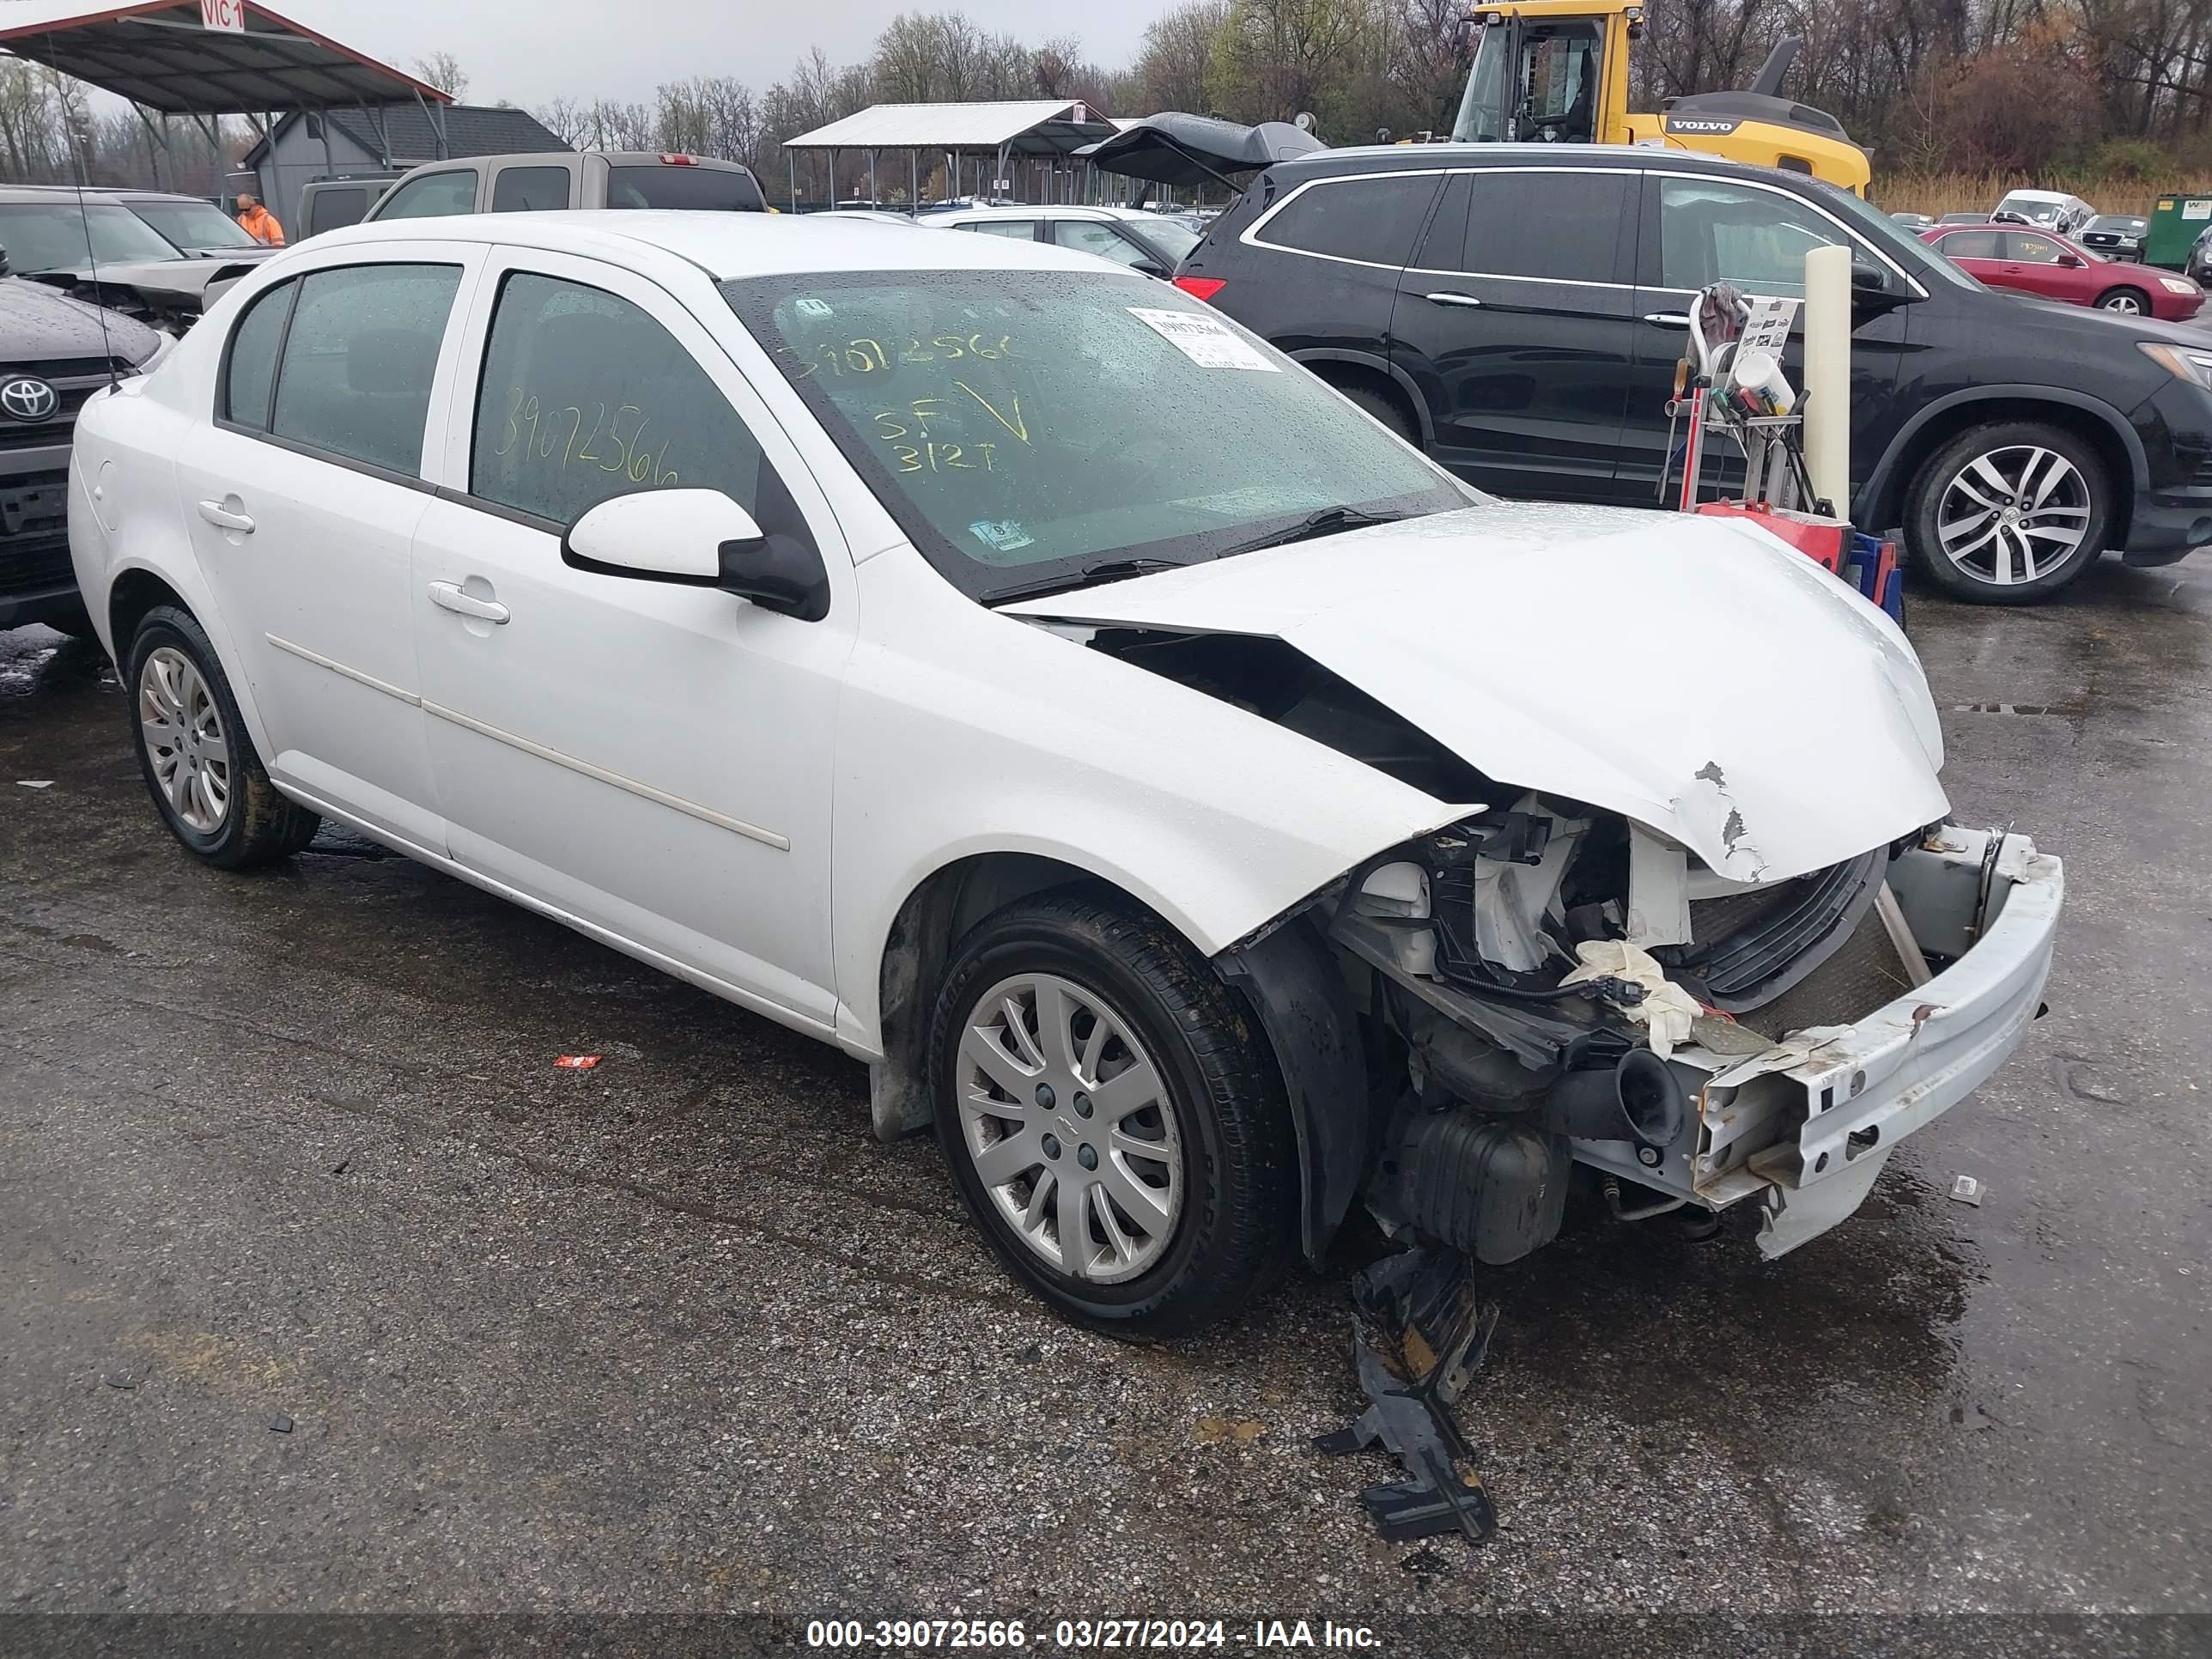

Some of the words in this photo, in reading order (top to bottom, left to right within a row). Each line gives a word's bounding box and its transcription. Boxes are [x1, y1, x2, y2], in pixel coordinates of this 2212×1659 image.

[203, 0, 231, 27] VIC
[234, 2, 243, 28] 1
[1672, 120, 1733, 131] VOLVO
